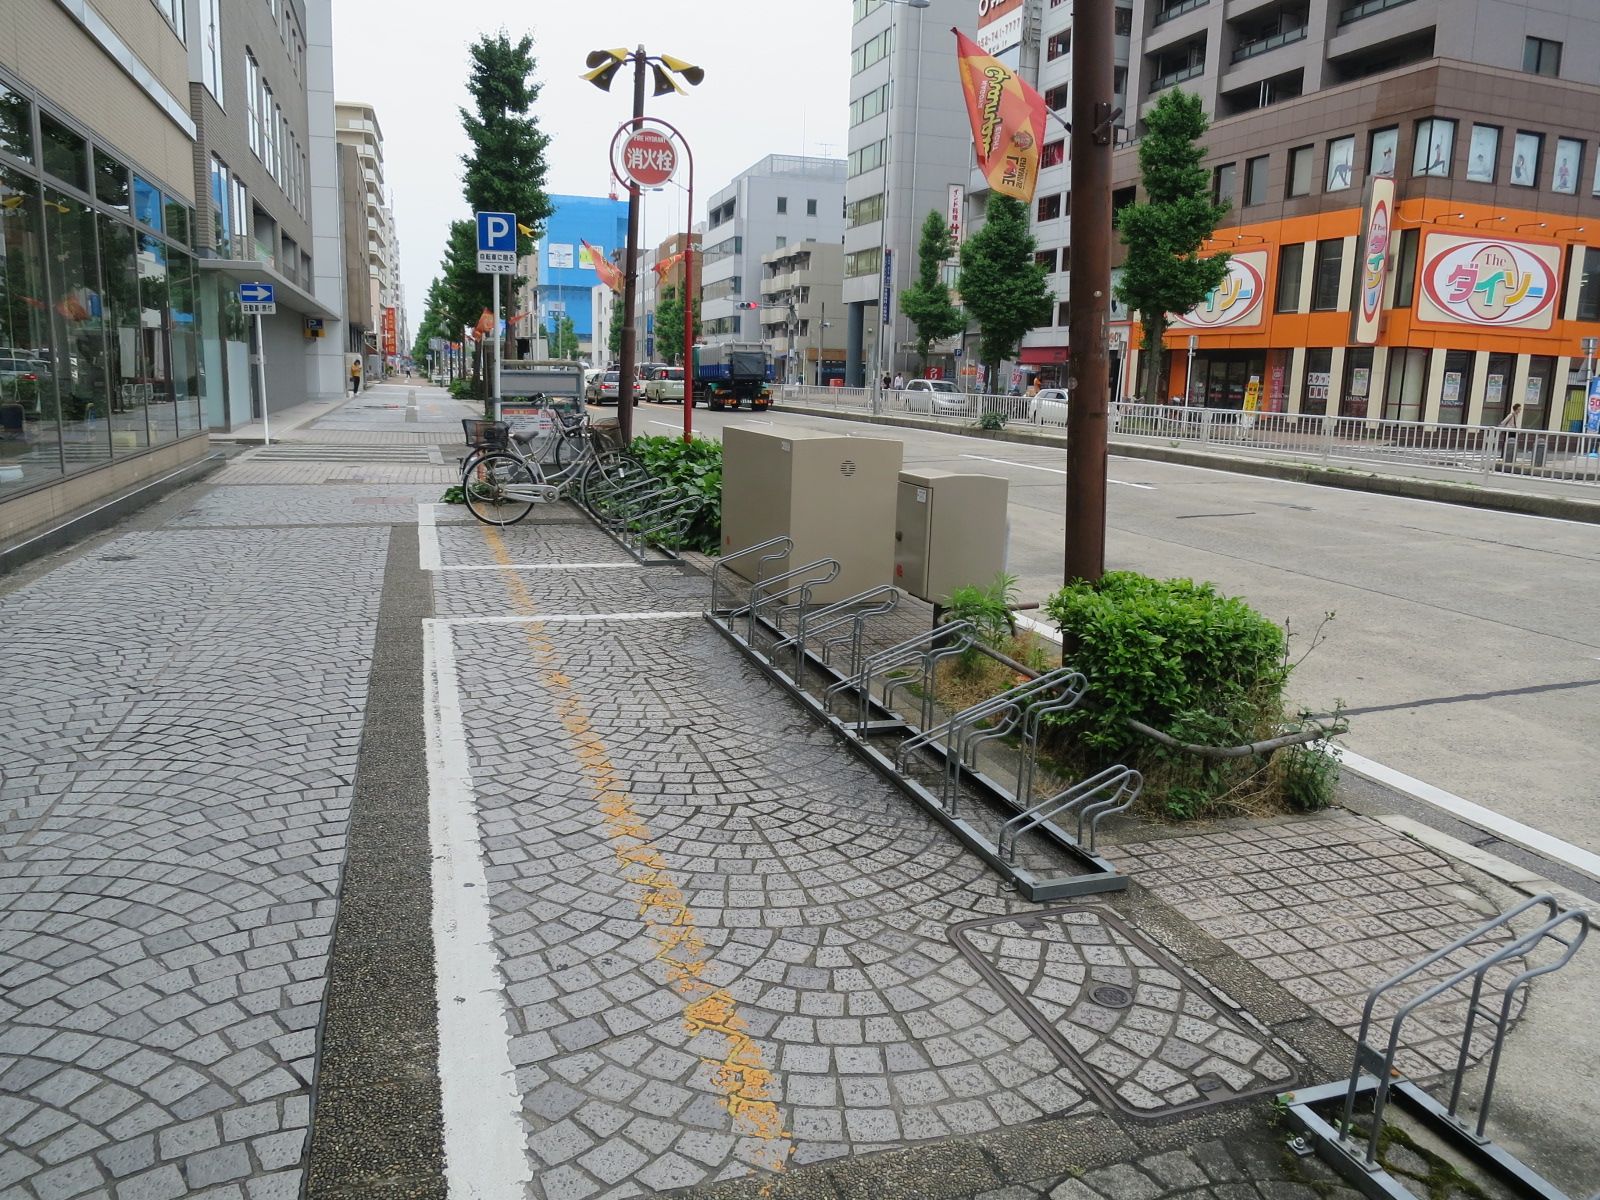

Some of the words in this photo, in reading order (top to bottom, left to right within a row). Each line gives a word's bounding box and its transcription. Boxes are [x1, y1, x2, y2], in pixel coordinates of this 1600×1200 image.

[627, 147, 673, 171] 消火栓
[487, 216, 509, 247] P
[1373, 223, 1386, 232] The
[480, 253, 514, 261] 自転車に限る
[1485, 253, 1507, 267] The
[1367, 235, 1386, 305] ダイソー
[1446, 263, 1545, 307] ダイソー
